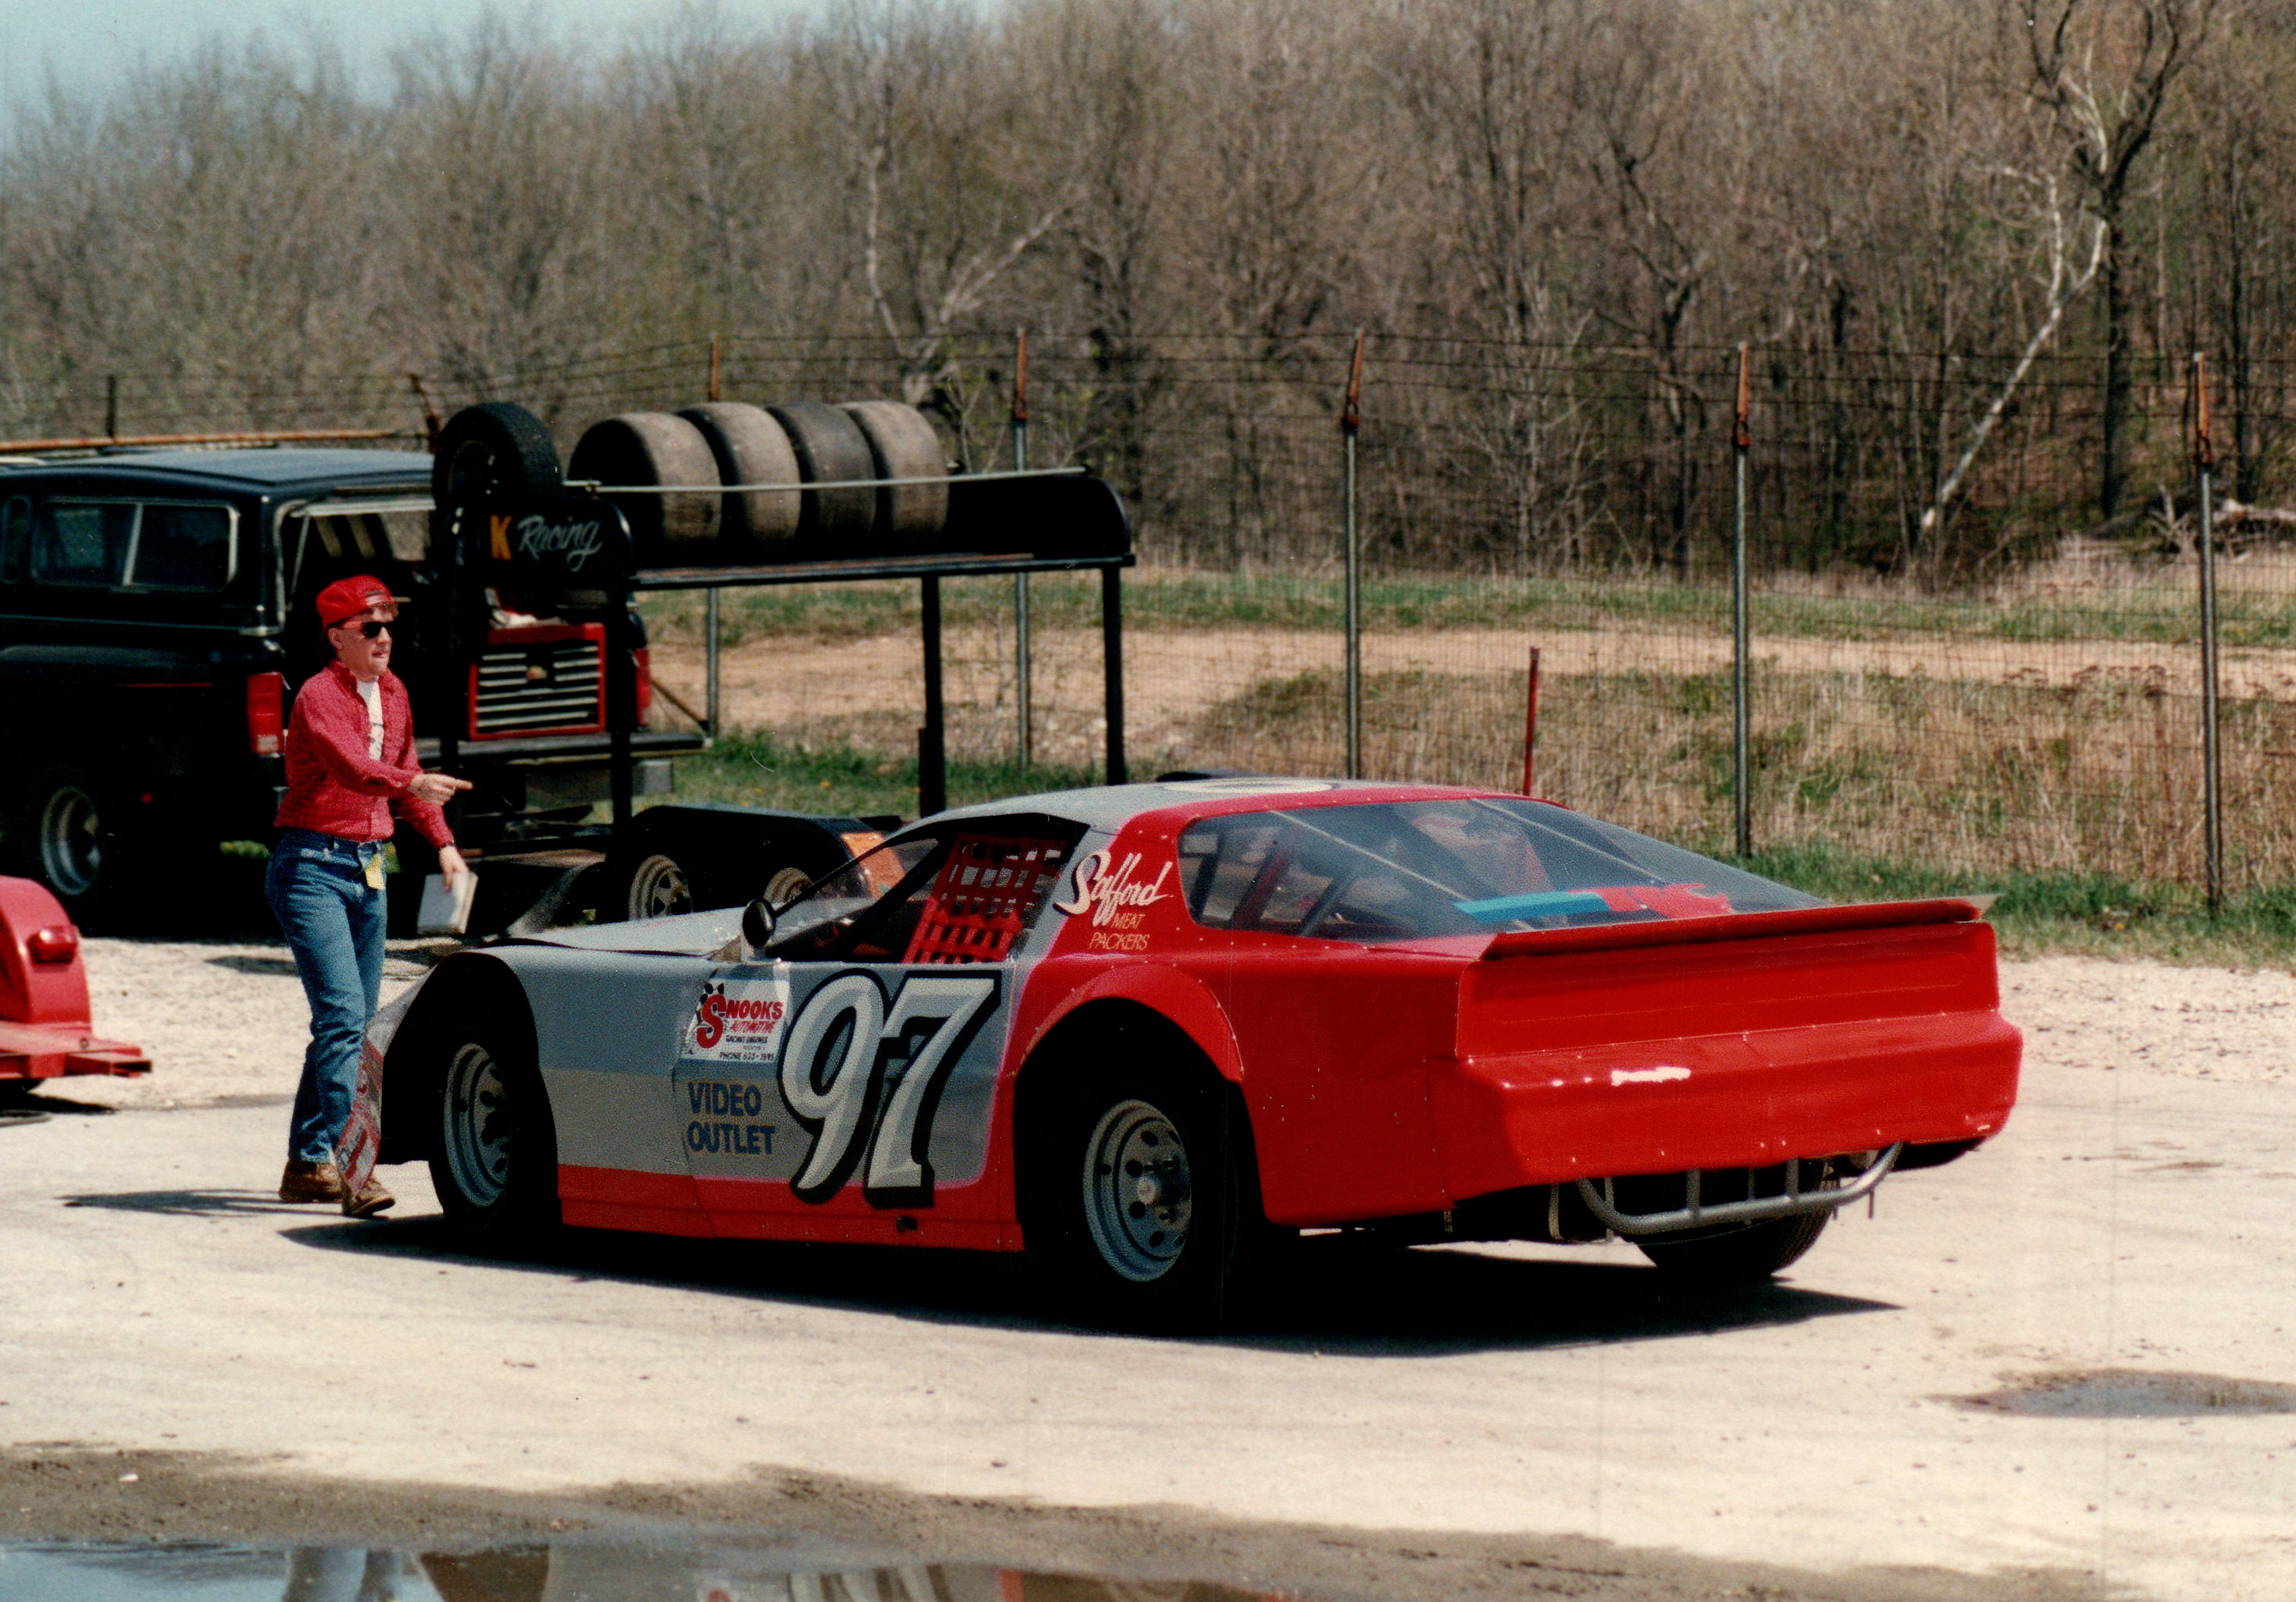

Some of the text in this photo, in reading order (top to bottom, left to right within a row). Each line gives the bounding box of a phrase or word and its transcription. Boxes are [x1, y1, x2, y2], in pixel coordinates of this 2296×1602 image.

[489, 514, 602, 572] K Racing
[1111, 912, 1146, 929] MEAT
[1088, 932, 1150, 951] PACKERS
[696, 994, 783, 1048] SNOOKS
[688, 1082, 762, 1116] VIDEO
[776, 968, 1002, 1209] 97
[687, 1121, 775, 1155] OUTLET
